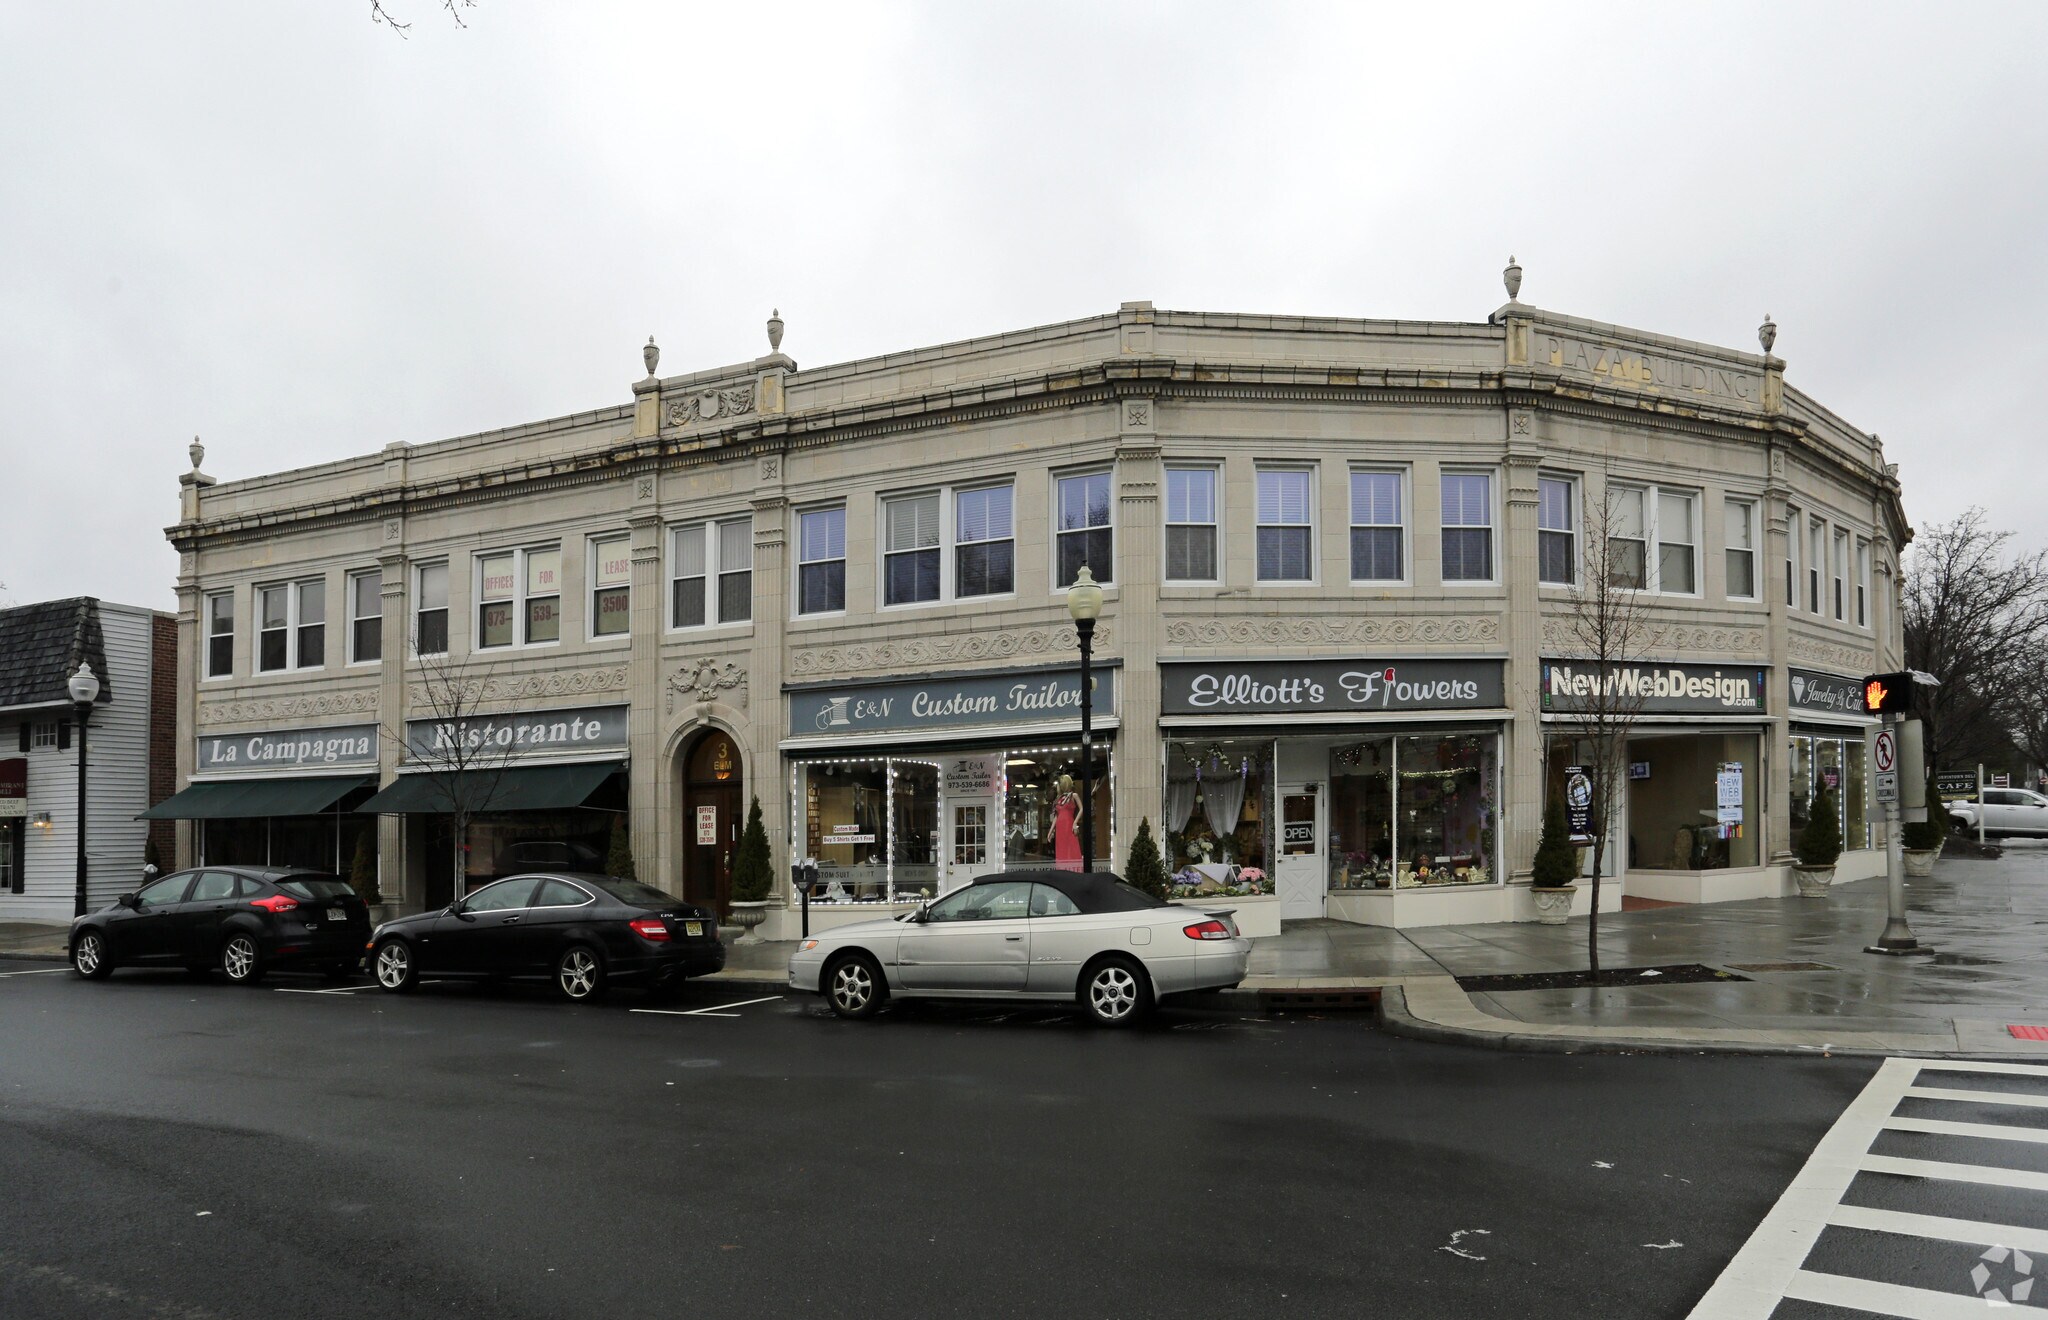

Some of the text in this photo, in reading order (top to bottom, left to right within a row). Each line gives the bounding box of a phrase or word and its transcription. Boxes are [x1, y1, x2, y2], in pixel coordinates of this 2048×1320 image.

[1547, 338, 1750, 398] PLAZA BUILDING
[485, 559, 629, 591] OFFICES FOR LEASE
[603, 595, 628, 613] 3500
[1188, 674, 1325, 707] Elliott's
[854, 681, 1083, 720] E&N Custom Tailor
[1733, 698, 1756, 707] .com
[433, 716, 601, 749] Ristorante
[210, 736, 369, 764] La Campagna
[718, 743, 728, 759] 3
[971, 771, 991, 779] Tailor
[1719, 779, 1739, 787] NEW
[1719, 788, 1740, 797] WEB
[1937, 782, 1973, 790] CAFE
[1284, 828, 1314, 839] OPEN
[817, 871, 834, 879] STOM
